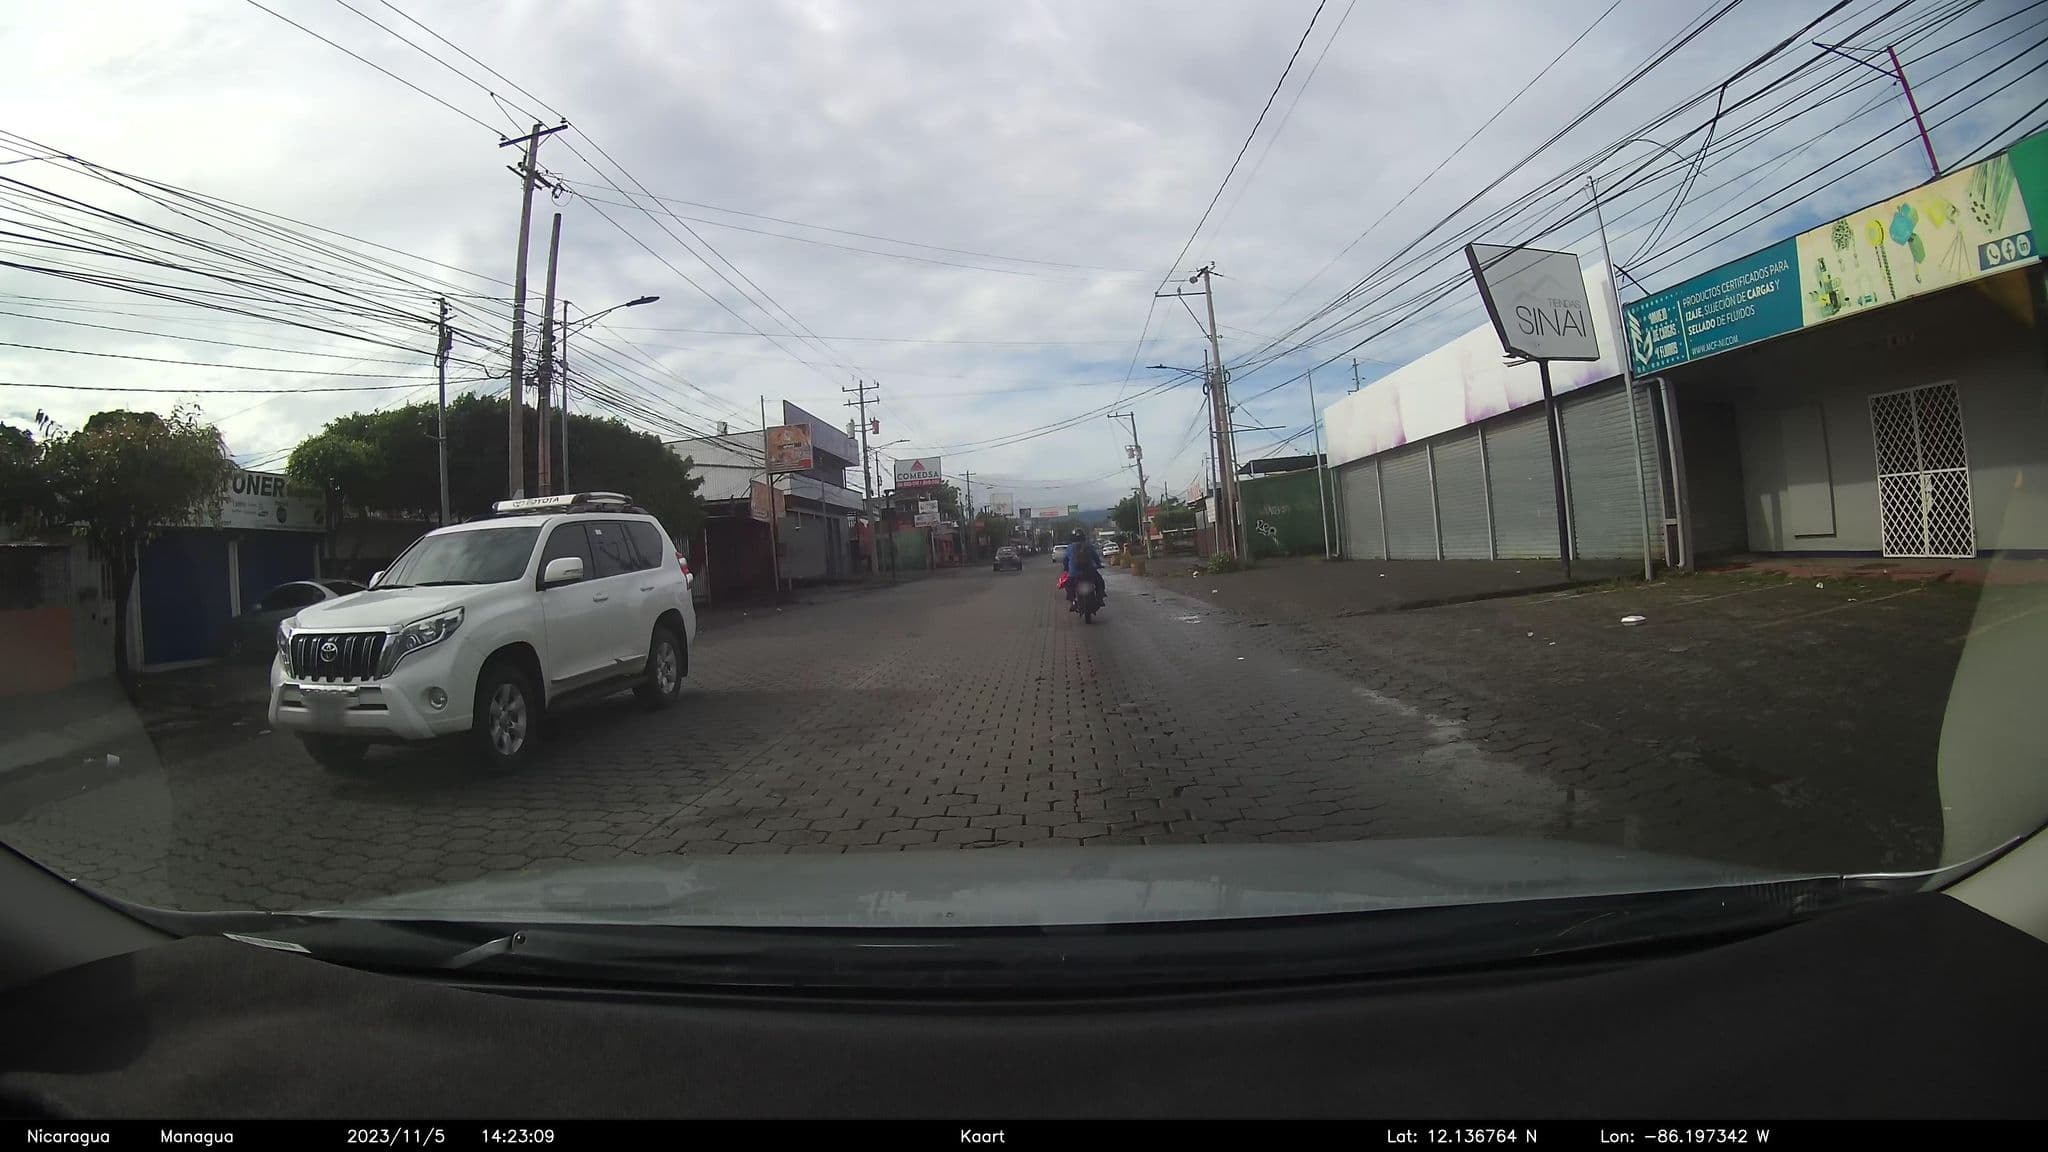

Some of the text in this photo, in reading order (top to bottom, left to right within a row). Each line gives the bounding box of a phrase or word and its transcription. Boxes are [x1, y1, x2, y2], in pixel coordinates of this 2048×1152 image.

[1683, 259, 1789, 308] PRODUCTOS CERTIFICADOS PARA
[1685, 279, 1780, 322] IZAJE, SUJECIÓN DE CARGAS Y
[1515, 305, 1587, 338] SINAI
[1688, 304, 1755, 336] SELLADO DE FLUIDOS
[897, 471, 939, 481] COMEDSA
